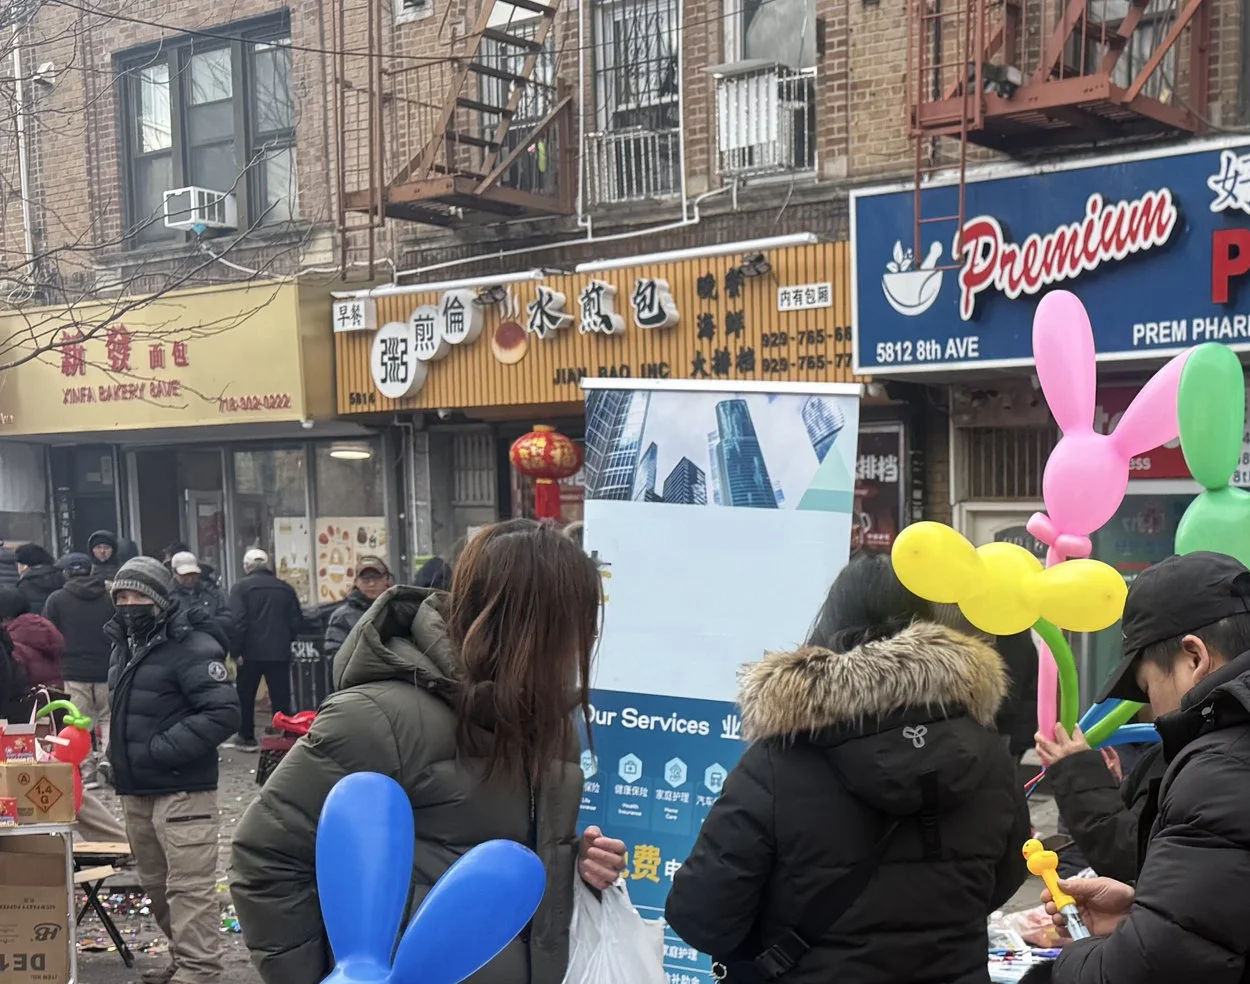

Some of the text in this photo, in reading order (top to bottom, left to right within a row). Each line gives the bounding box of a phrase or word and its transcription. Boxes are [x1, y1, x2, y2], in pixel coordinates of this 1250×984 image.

[952, 188, 1177, 321] Premium
[337, 305, 362, 327] 早餐
[1133, 321, 1187, 346] PREM
[876, 337, 979, 362] 5812 8th AVE
[99, 382, 146, 402] BAKERY
[621, 708, 710, 735] Services
[40, 795, 49, 804] G
